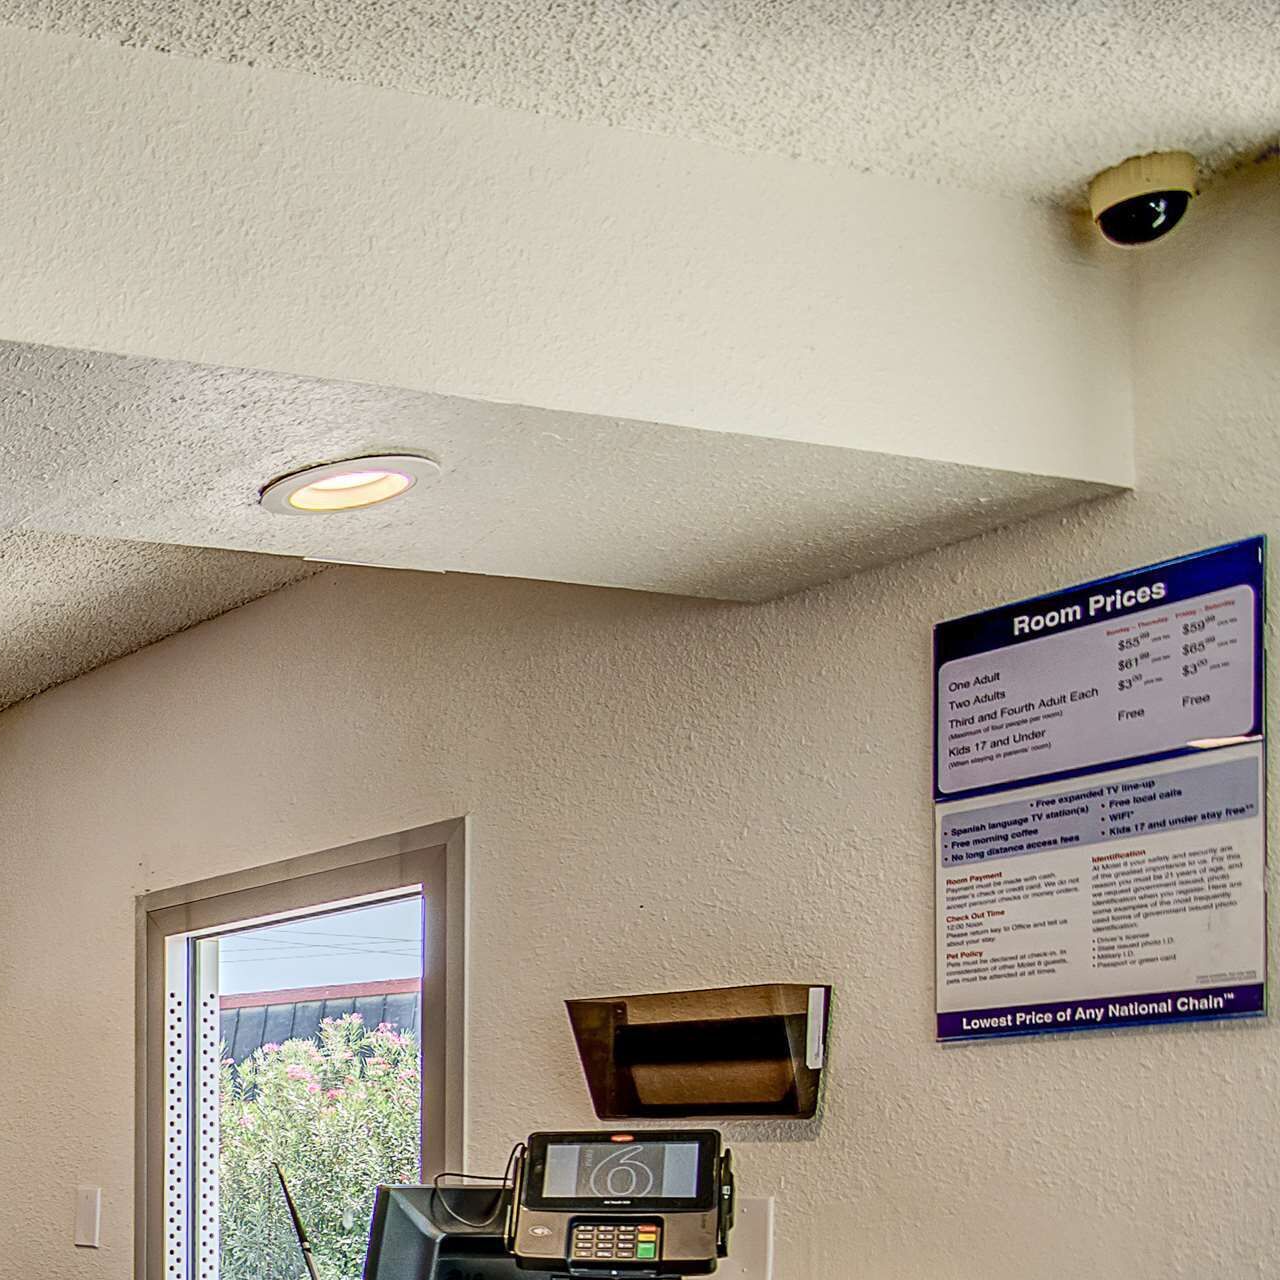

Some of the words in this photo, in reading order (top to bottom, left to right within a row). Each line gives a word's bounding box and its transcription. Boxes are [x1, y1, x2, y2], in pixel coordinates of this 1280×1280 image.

[1013, 604, 1081, 636] Room
[1088, 581, 1166, 616] Prices
[947, 681, 970, 692] One
[972, 672, 1000, 685] Adult
[948, 699, 970, 710] Two
[972, 691, 1005, 704] Adults
[948, 715, 974, 728] Third
[977, 710, 997, 722] and
[1000, 702, 1034, 717] Fourth
[1037, 695, 1066, 708] Adult
[1069, 688, 1098, 701] Each
[1181, 694, 1210, 706] Free
[1117, 708, 1144, 720] Free
[948, 745, 970, 756] Kids
[974, 740, 985, 751] 17
[989, 735, 1009, 748] and
[1012, 729, 1045, 743] Under
[1035, 799, 1056, 807] Free
[1057, 788, 1103, 803] expanded
[1106, 785, 1118, 794] TV
[1121, 780, 1155, 791] line-up
[1108, 798, 1130, 808] Free
[1132, 792, 1156, 803] local
[1158, 788, 1182, 799] calls
[950, 824, 985, 836] Spanish
[987, 817, 1028, 829] language
[1031, 812, 1043, 821] TV
[1108, 826, 1131, 835] Kids
[1134, 822, 1145, 831] 17
[1147, 819, 1166, 829] and
[1168, 815, 1198, 825] under
[1200, 811, 1222, 819] stay
[951, 840, 970, 849] Free
[972, 834, 1009, 845] morning
[1010, 828, 1038, 838] coffee
[965, 851, 984, 859] long
[986, 844, 1024, 855] distance
[1025, 838, 1057, 849] access
[1060, 835, 1079, 843] fees
[1091, 850, 1146, 862] Identification
[945, 877, 967, 885] Room
[969, 871, 1002, 881] Payment
[945, 914, 969, 922] Check
[962, 1014, 1012, 1029] Lowest
[1015, 1011, 1052, 1024] Price
[1056, 1008, 1071, 1021] of
[1074, 1007, 1104, 1020] Any
[1106, 999, 1171, 1016] National
